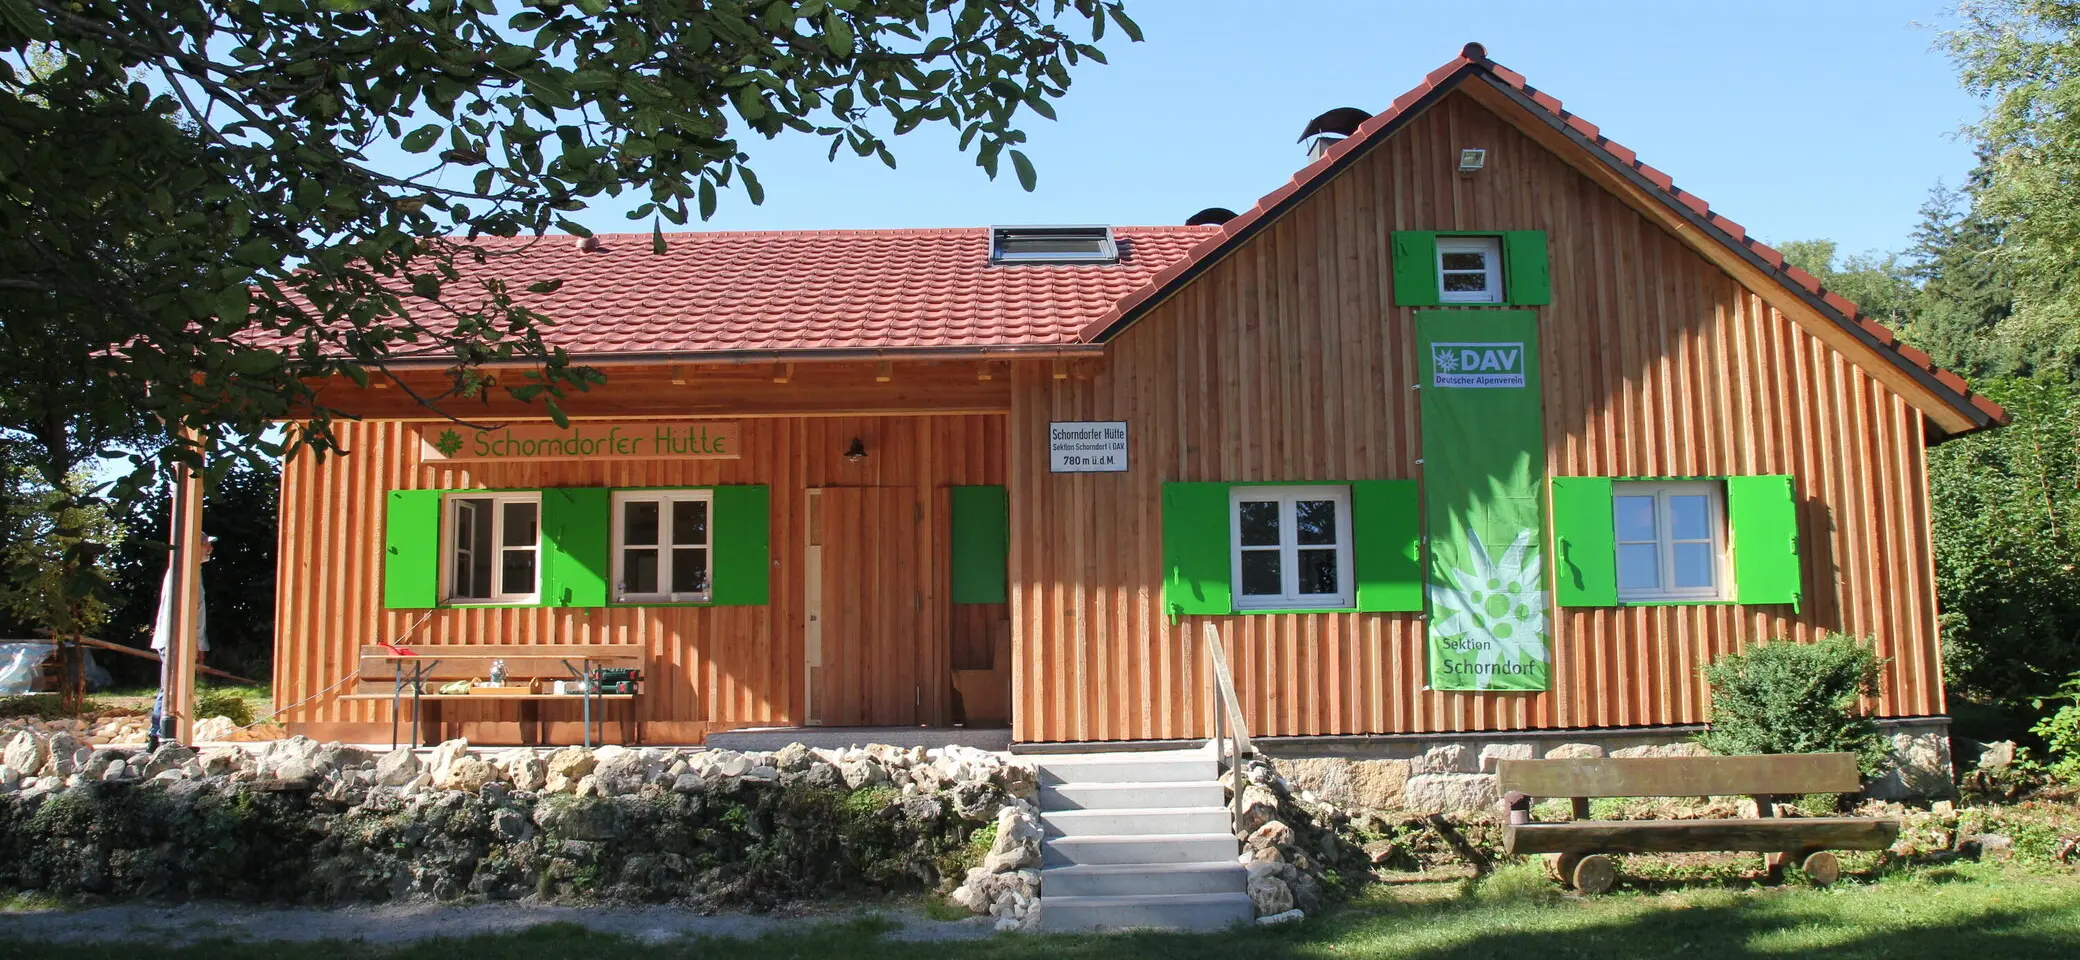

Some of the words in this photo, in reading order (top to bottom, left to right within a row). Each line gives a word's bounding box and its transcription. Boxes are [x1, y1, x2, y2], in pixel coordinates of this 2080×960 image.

[1461, 349, 1518, 371] DAV
[1436, 375, 1474, 384] Deutscher
[1476, 376, 1523, 385] Alpenverein
[1053, 428, 1101, 440] Schorndorfer
[1105, 428, 1124, 439] Hütte
[474, 427, 643, 456] Schorndorfer
[655, 425, 727, 454] Hütte
[1053, 443, 1074, 451] Sektion
[1064, 456, 1080, 465] 780
[1442, 638, 1491, 650] Sektion
[1443, 659, 1536, 675] Schorndorf
